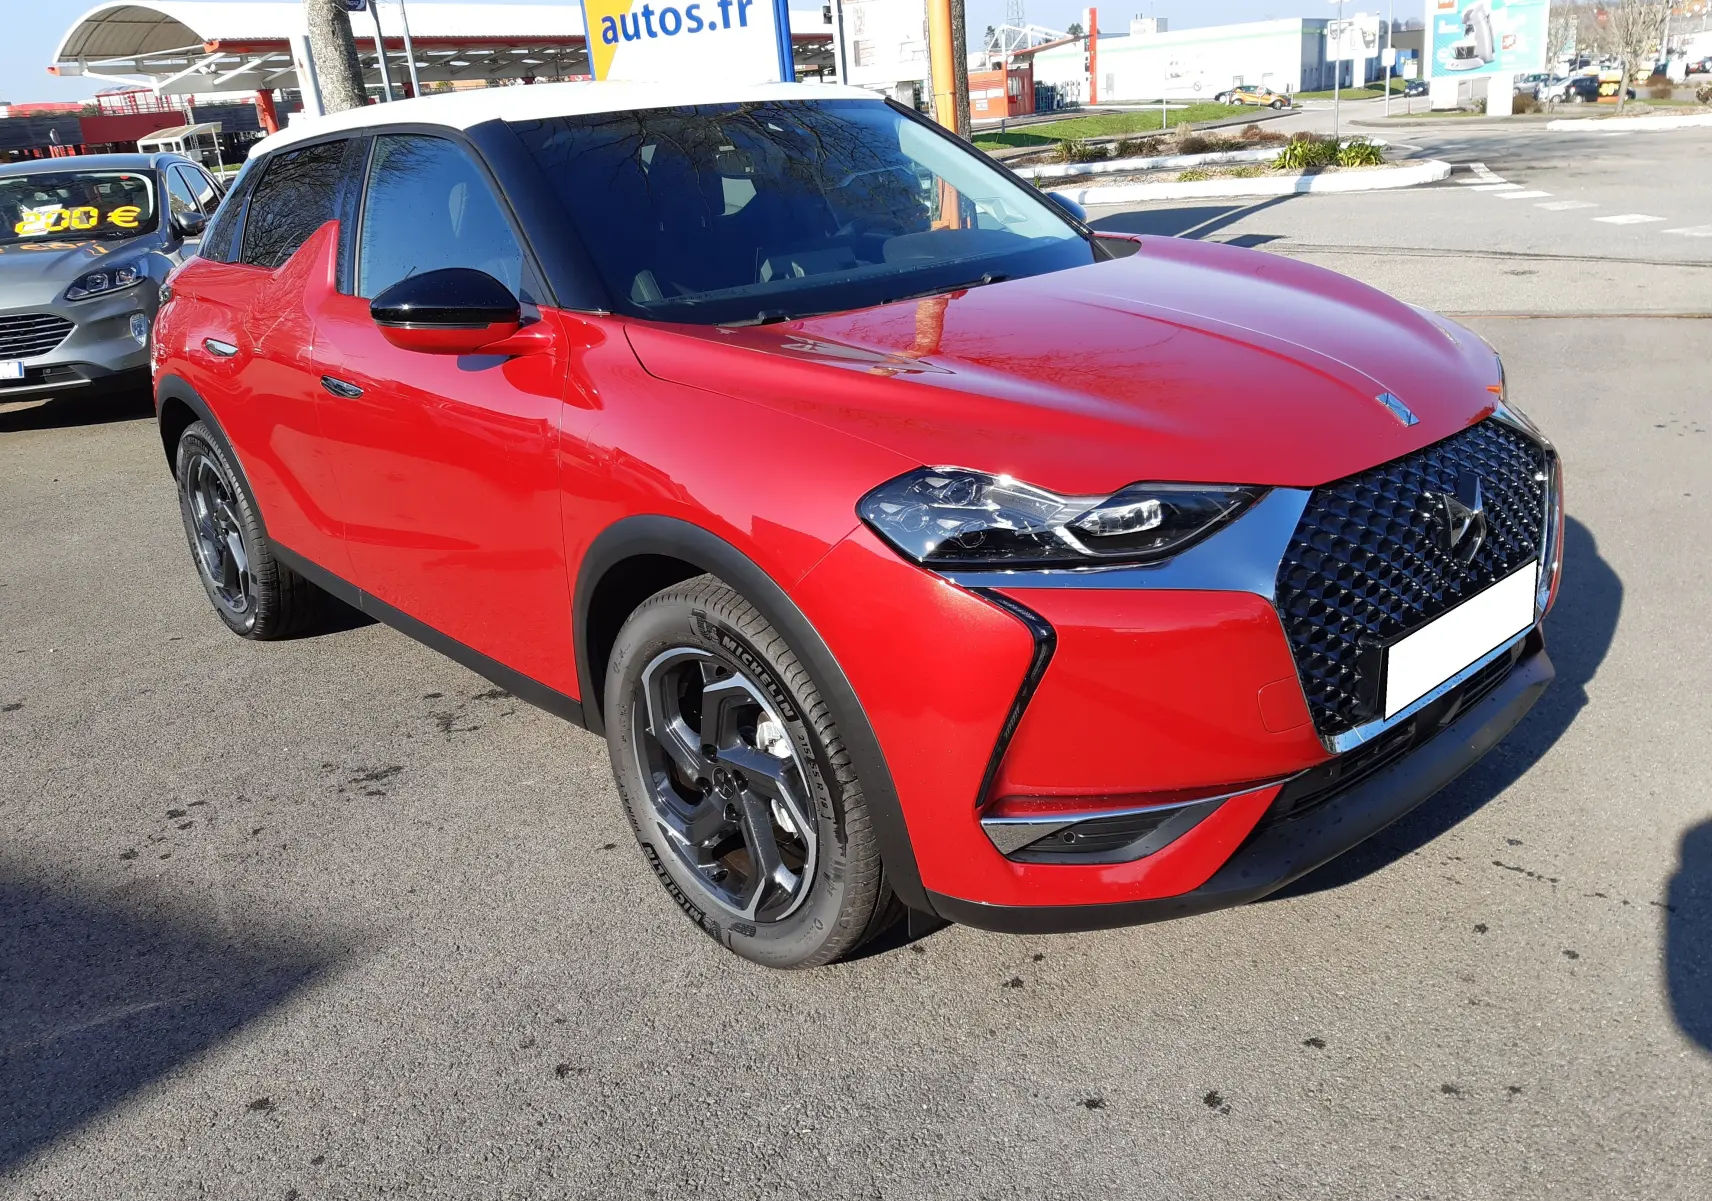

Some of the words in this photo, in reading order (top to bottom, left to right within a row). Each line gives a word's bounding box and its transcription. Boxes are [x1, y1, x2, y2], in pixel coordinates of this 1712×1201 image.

[601, 0, 753, 44] autos.fr
[15, 206, 98, 234] 200
[107, 205, 141, 228] €
[722, 635, 795, 717] MICHELIN
[644, 846, 703, 923] MICHELIN
